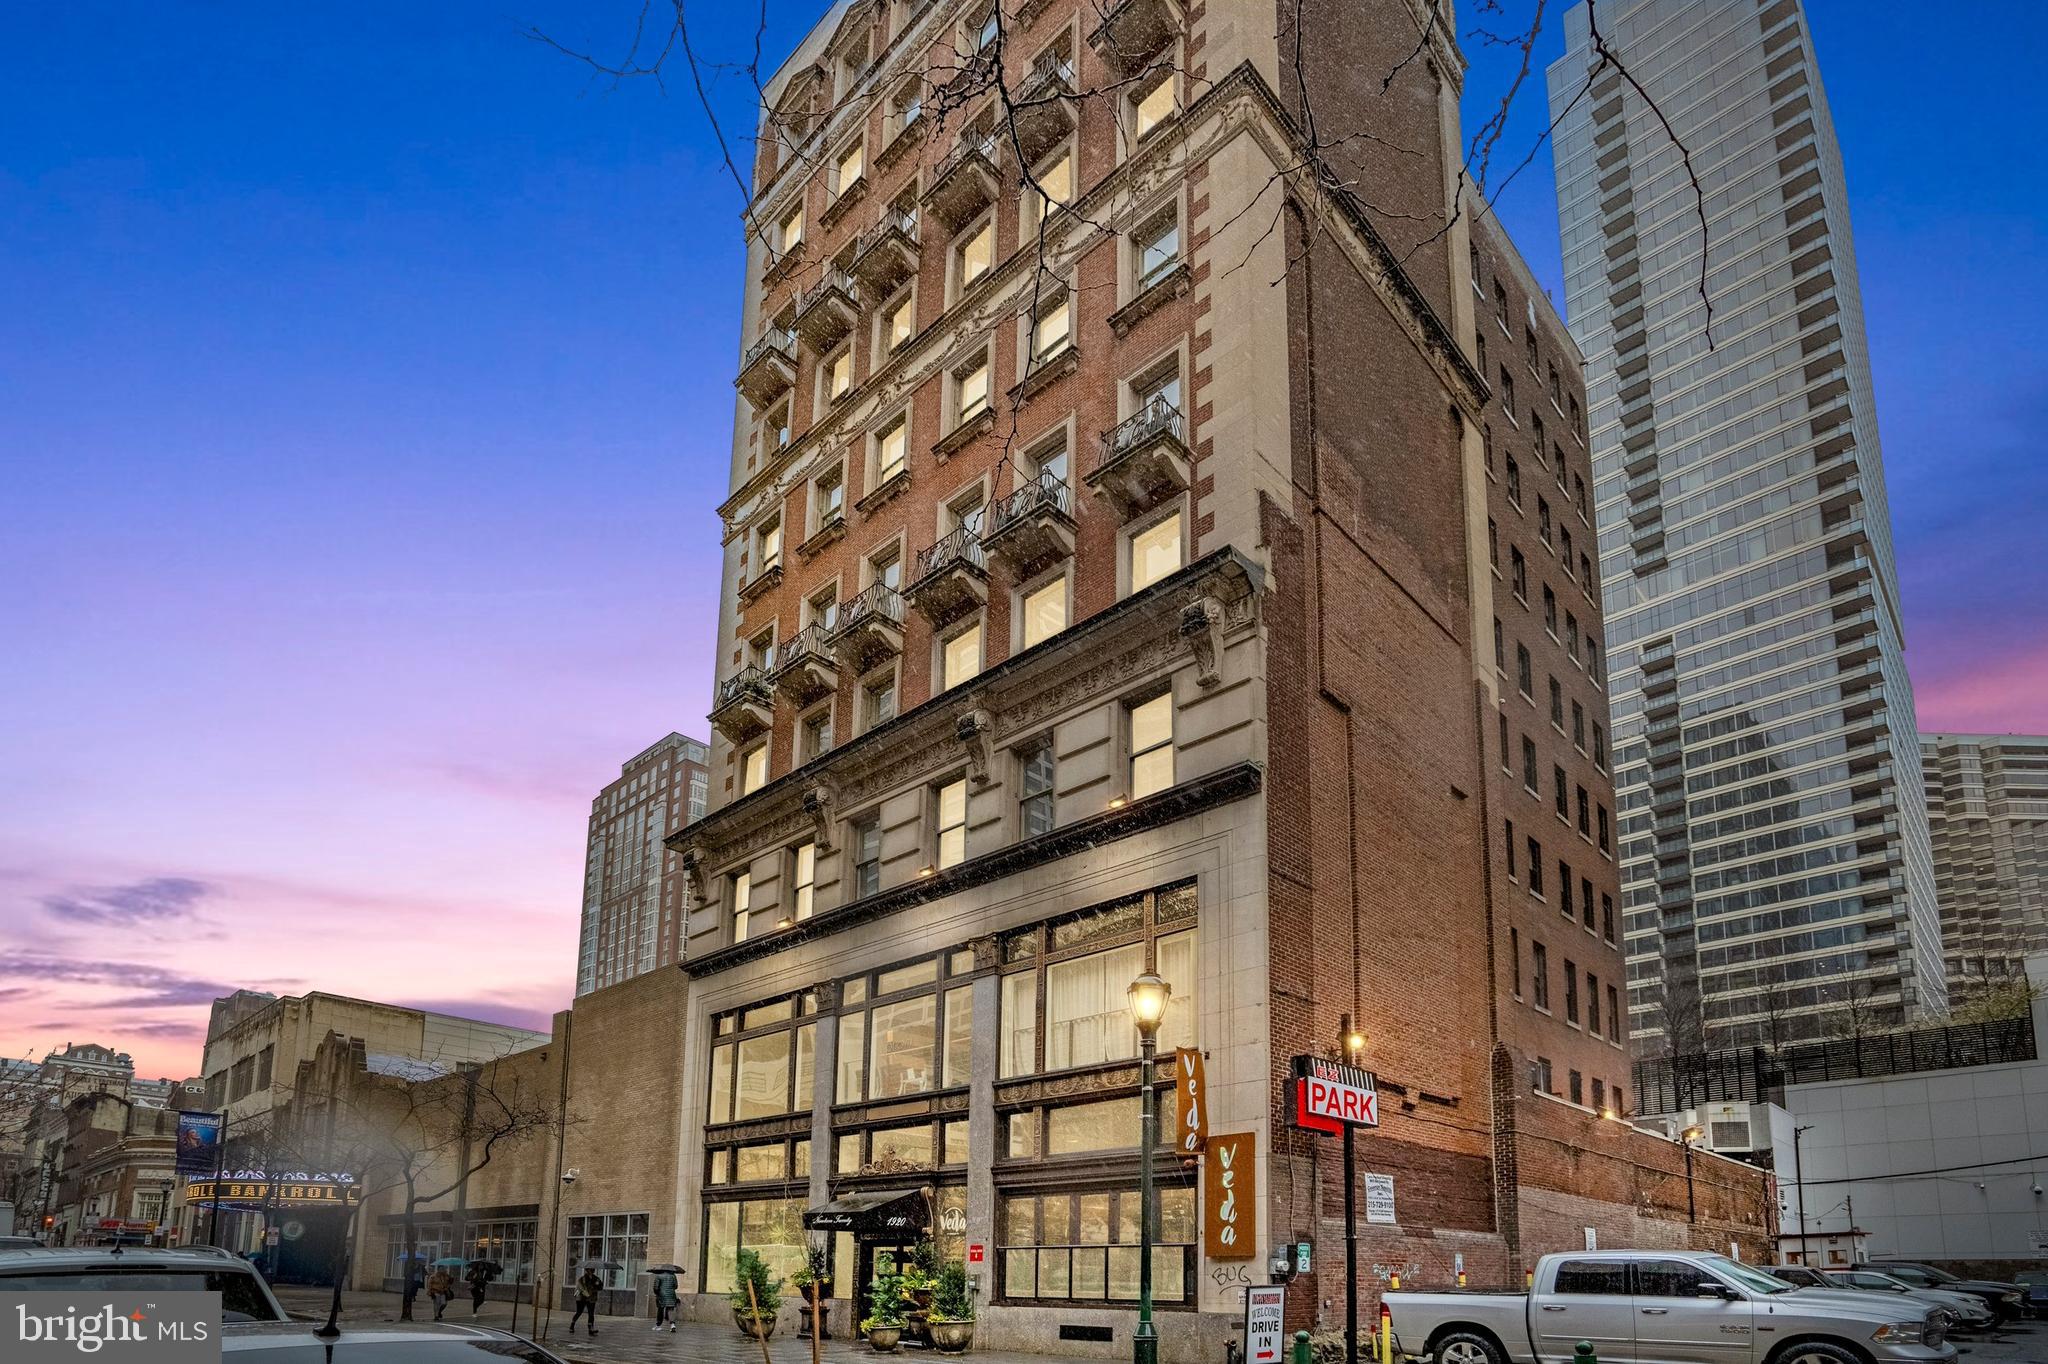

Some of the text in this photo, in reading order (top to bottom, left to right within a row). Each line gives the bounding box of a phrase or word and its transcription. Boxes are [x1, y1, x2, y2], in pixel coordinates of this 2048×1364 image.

[1183, 1054, 1200, 1151] Veda
[1312, 1082, 1375, 1123] PARK
[180, 1115, 219, 1125] Beautiful
[1220, 1143, 1238, 1246] Veda
[887, 1216, 906, 1226] 1920
[939, 1210, 967, 1232] Veda
[1301, 1258, 1307, 1269] 2
[1252, 1307, 1280, 1319] WELCOME
[1252, 1320, 1279, 1333] DRIVE
[1259, 1336, 1271, 1347] IN
